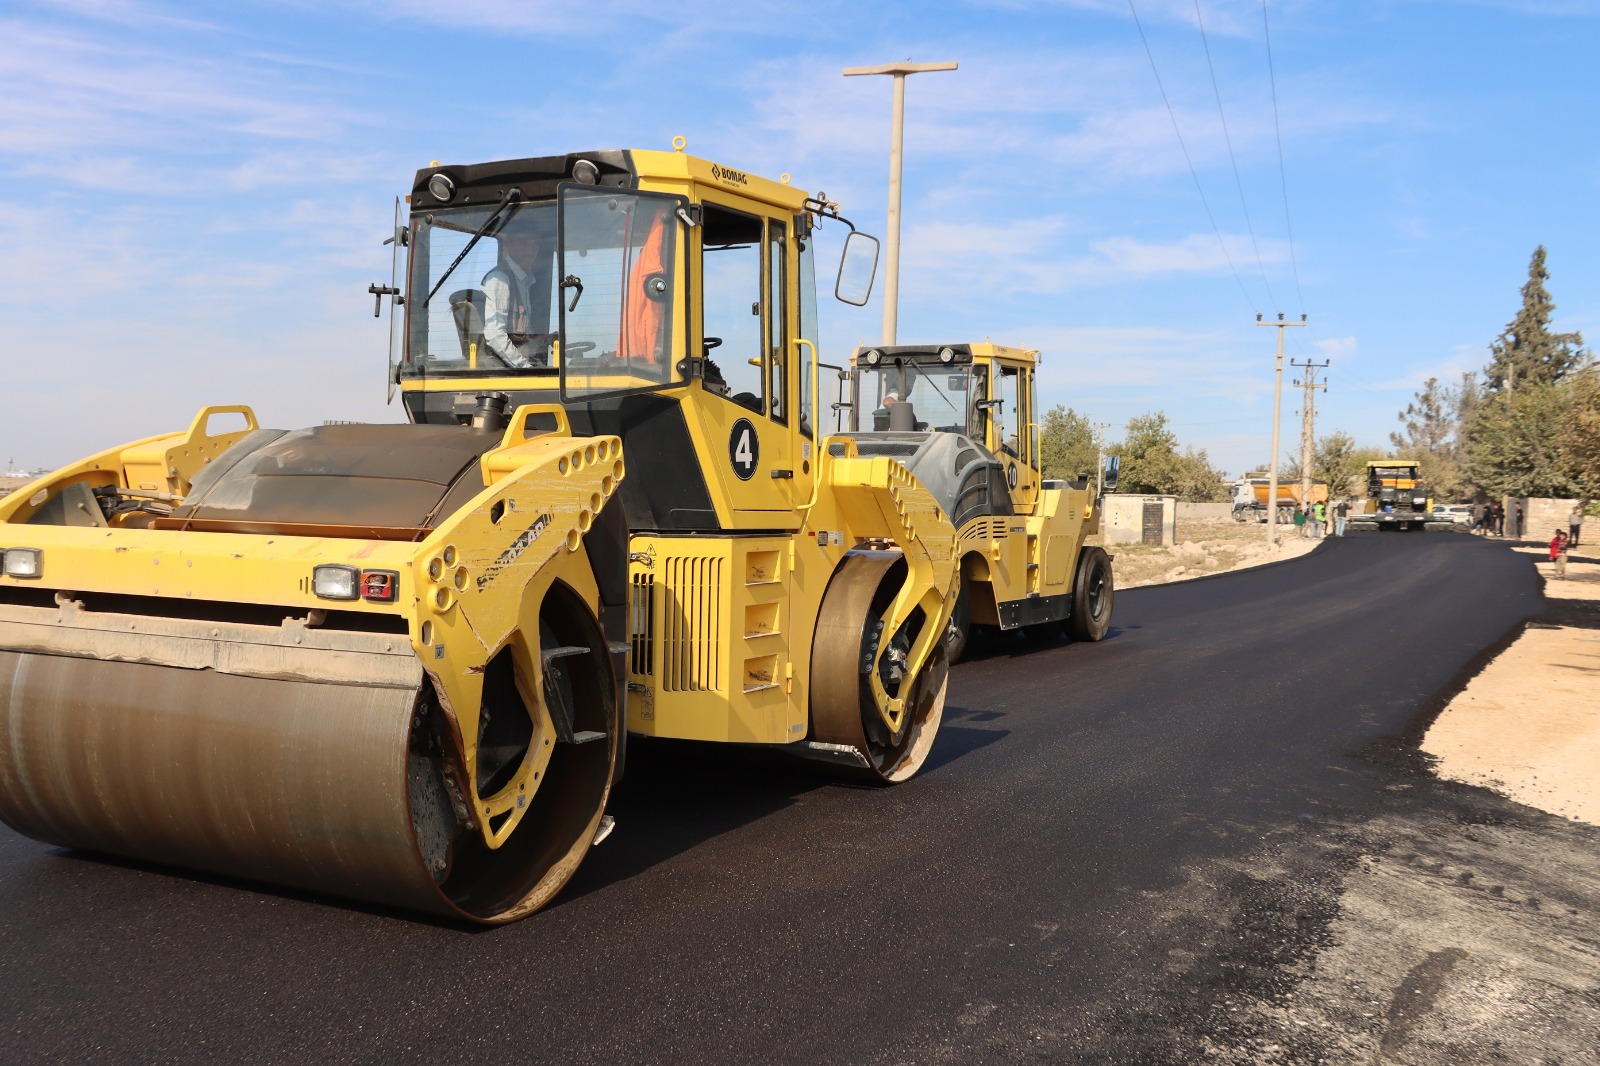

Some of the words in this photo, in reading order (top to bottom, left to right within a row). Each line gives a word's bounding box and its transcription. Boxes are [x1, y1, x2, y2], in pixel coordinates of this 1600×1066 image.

[721, 168, 748, 185] BOMAG
[735, 429, 753, 469] 4
[1008, 466, 1017, 487] 10
